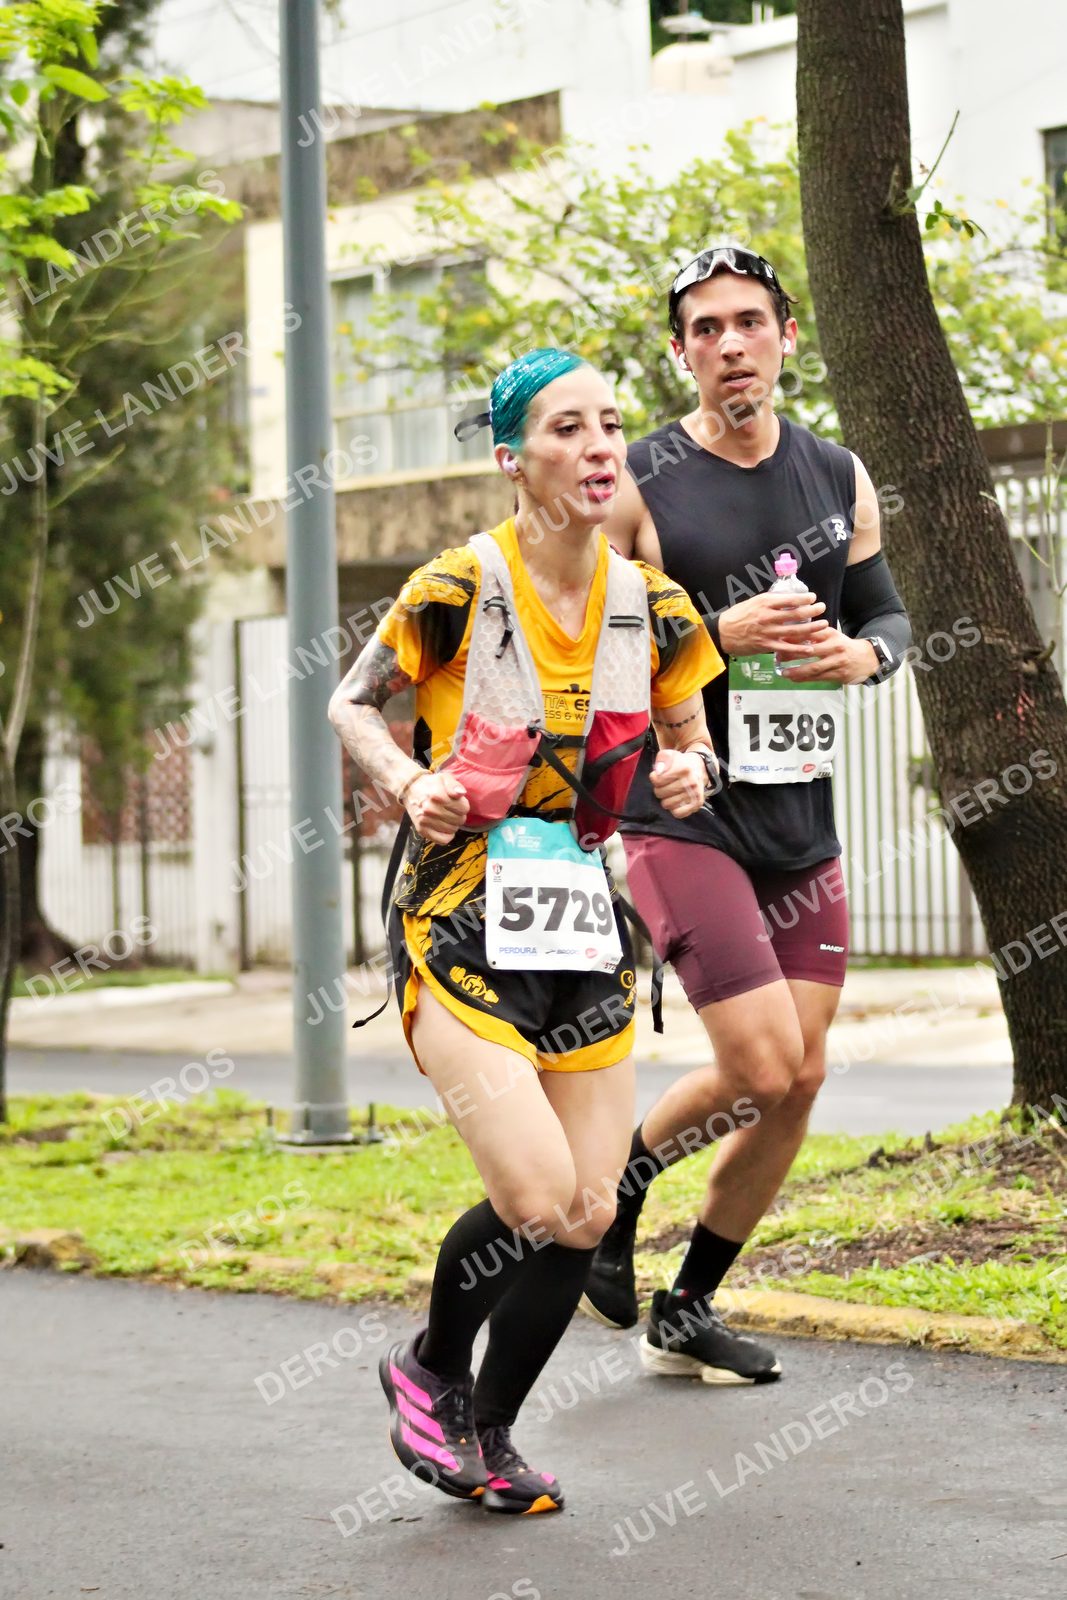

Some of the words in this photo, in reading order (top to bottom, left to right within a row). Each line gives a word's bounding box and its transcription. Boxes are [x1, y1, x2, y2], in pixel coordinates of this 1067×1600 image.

[743, 713, 836, 752] 1389
[498, 886, 613, 936] 5729
[499, 947, 537, 955] PERDURA
